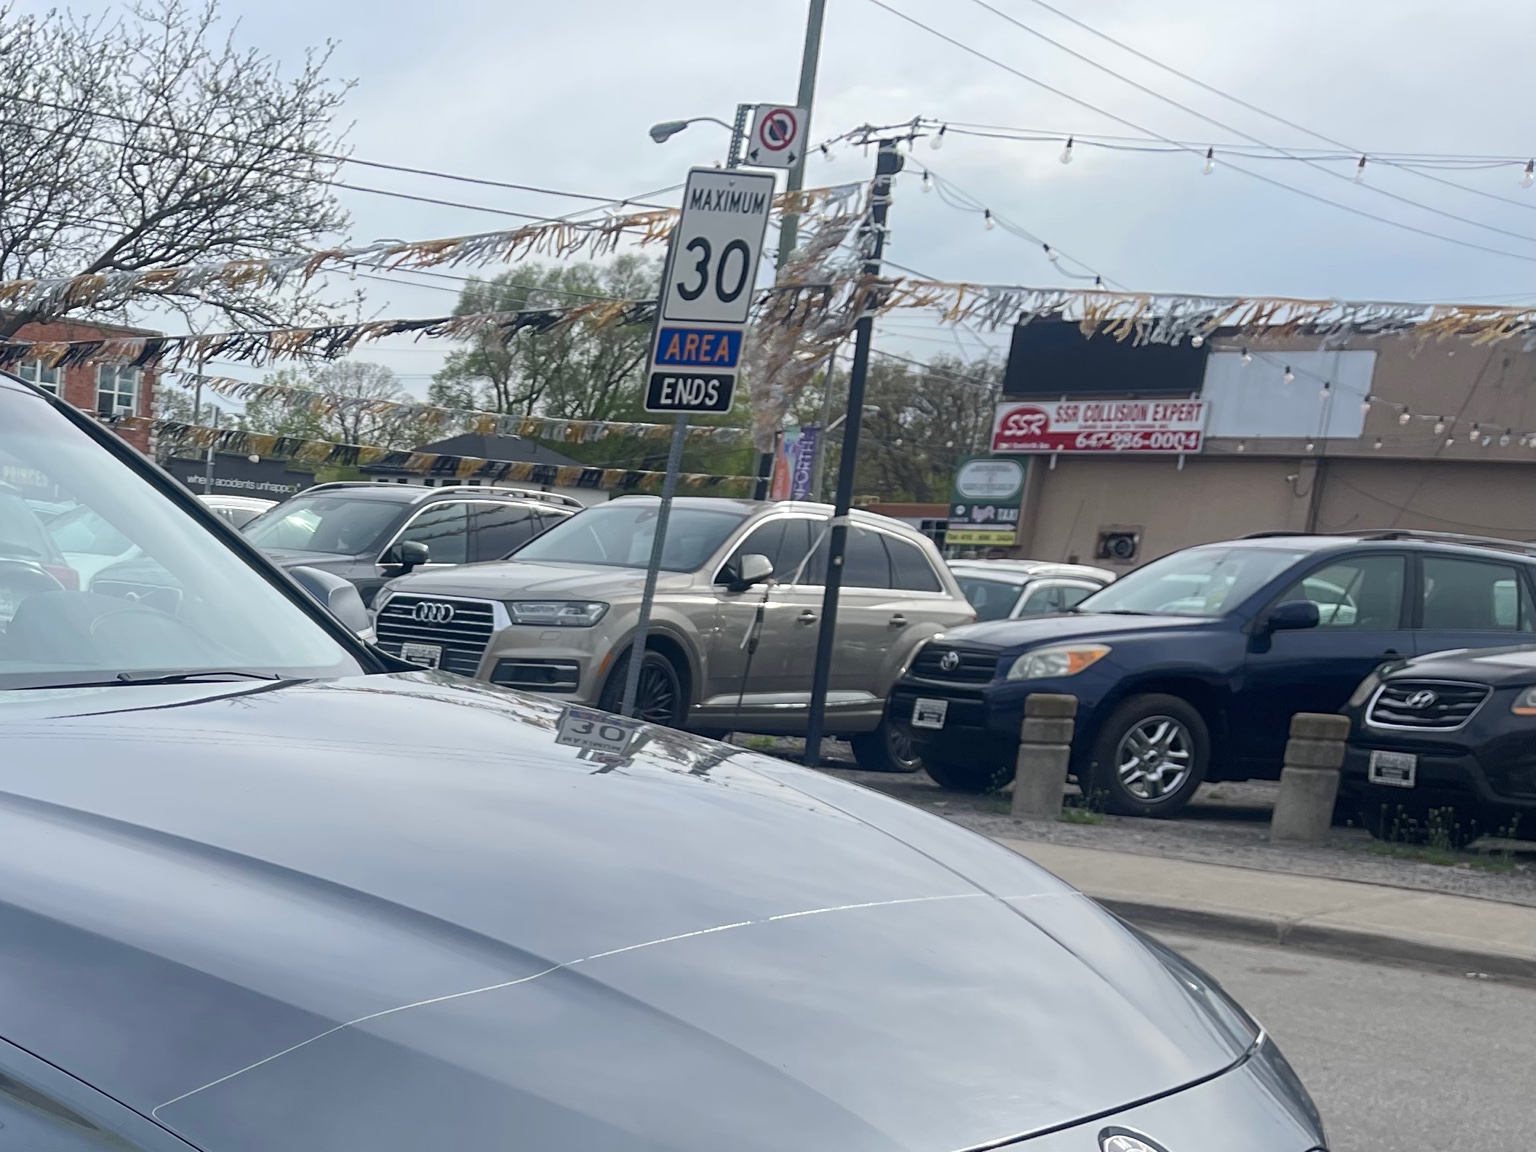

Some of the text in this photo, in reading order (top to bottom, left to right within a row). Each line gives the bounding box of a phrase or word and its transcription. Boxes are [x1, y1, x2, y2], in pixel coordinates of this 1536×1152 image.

[689, 188, 767, 215] MAXIMUM
[677, 236, 751, 303] 30
[665, 333, 730, 363] AREA
[659, 378, 720, 406] ENDS
[1003, 413, 1048, 436] SSR
[1054, 403, 1203, 424] SSR COLLISION EXPERT
[187, 475, 214, 485] whee
[215, 477, 255, 489] accidents
